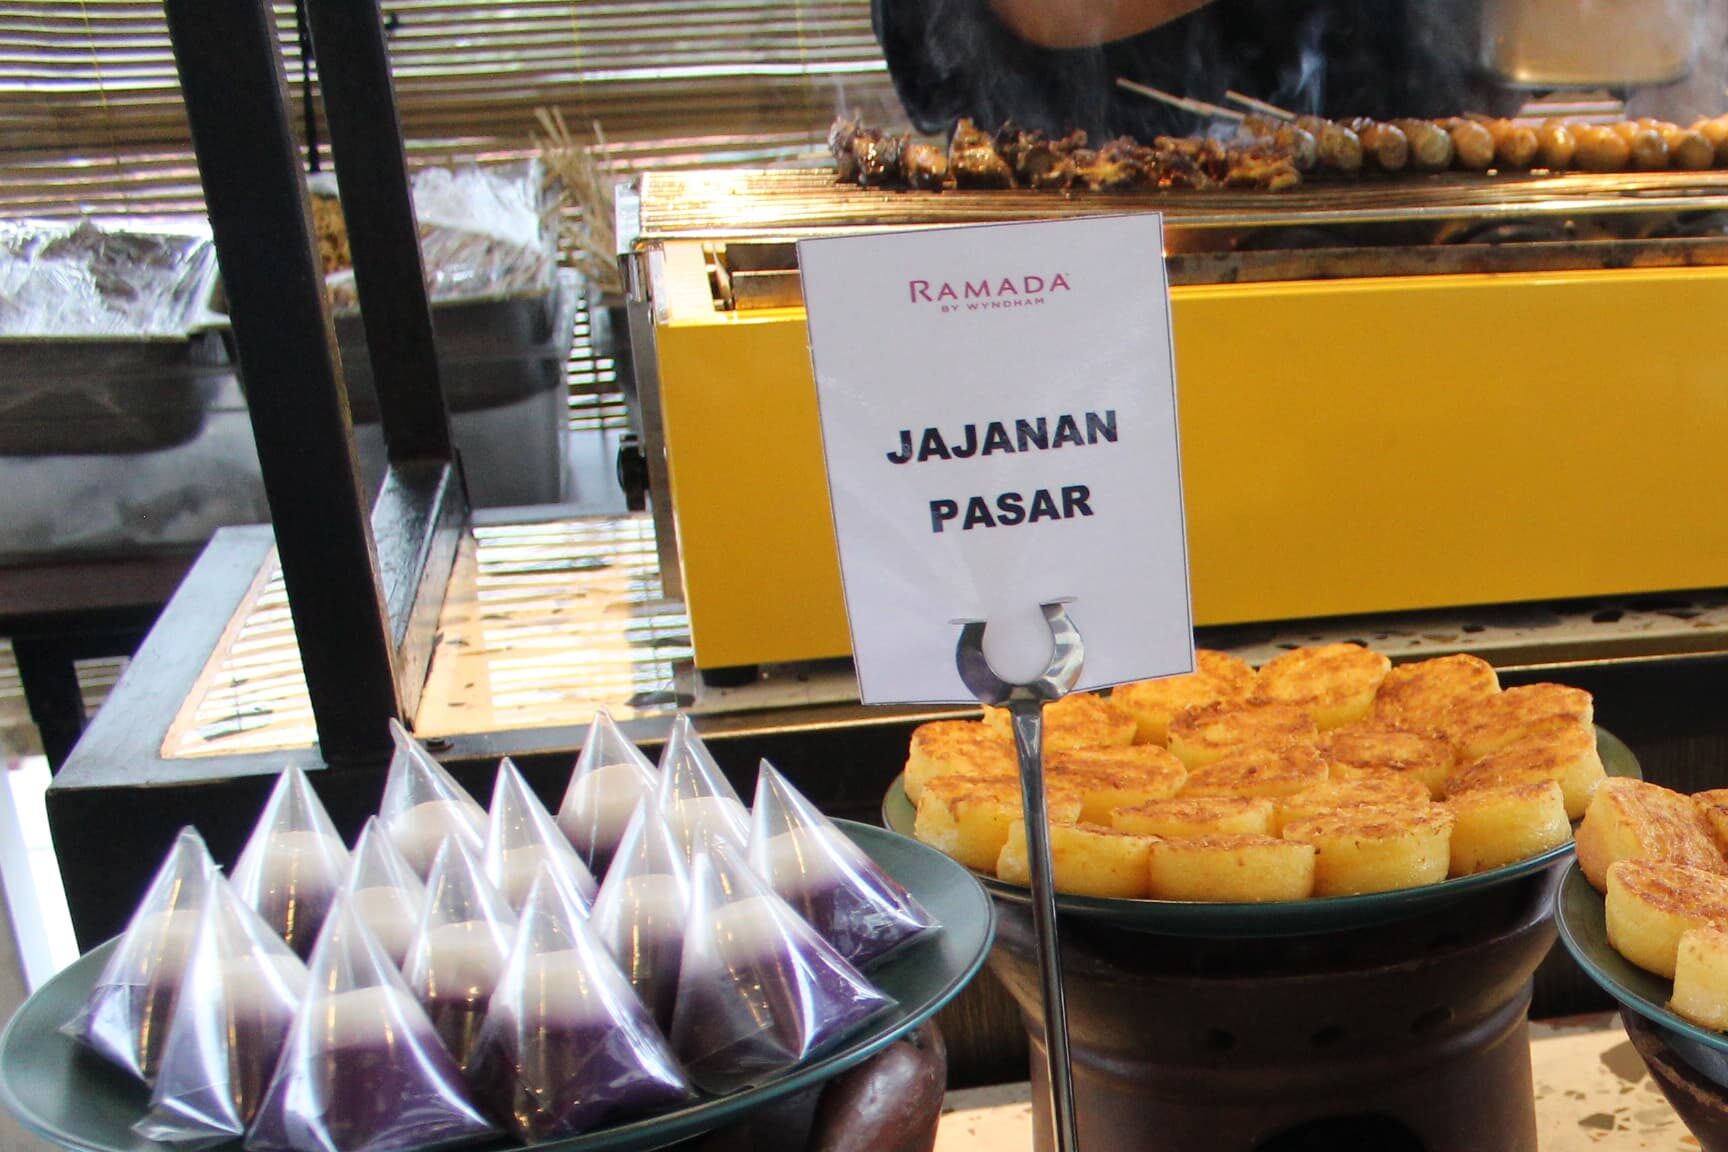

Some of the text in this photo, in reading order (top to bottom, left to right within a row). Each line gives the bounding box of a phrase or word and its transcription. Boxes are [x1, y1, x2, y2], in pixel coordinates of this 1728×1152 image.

[909, 273, 1070, 303] RAMADA
[941, 297, 1045, 313] BY WYNDHAM
[886, 410, 1119, 465] JAJANAN
[929, 484, 1094, 533] PASAR
